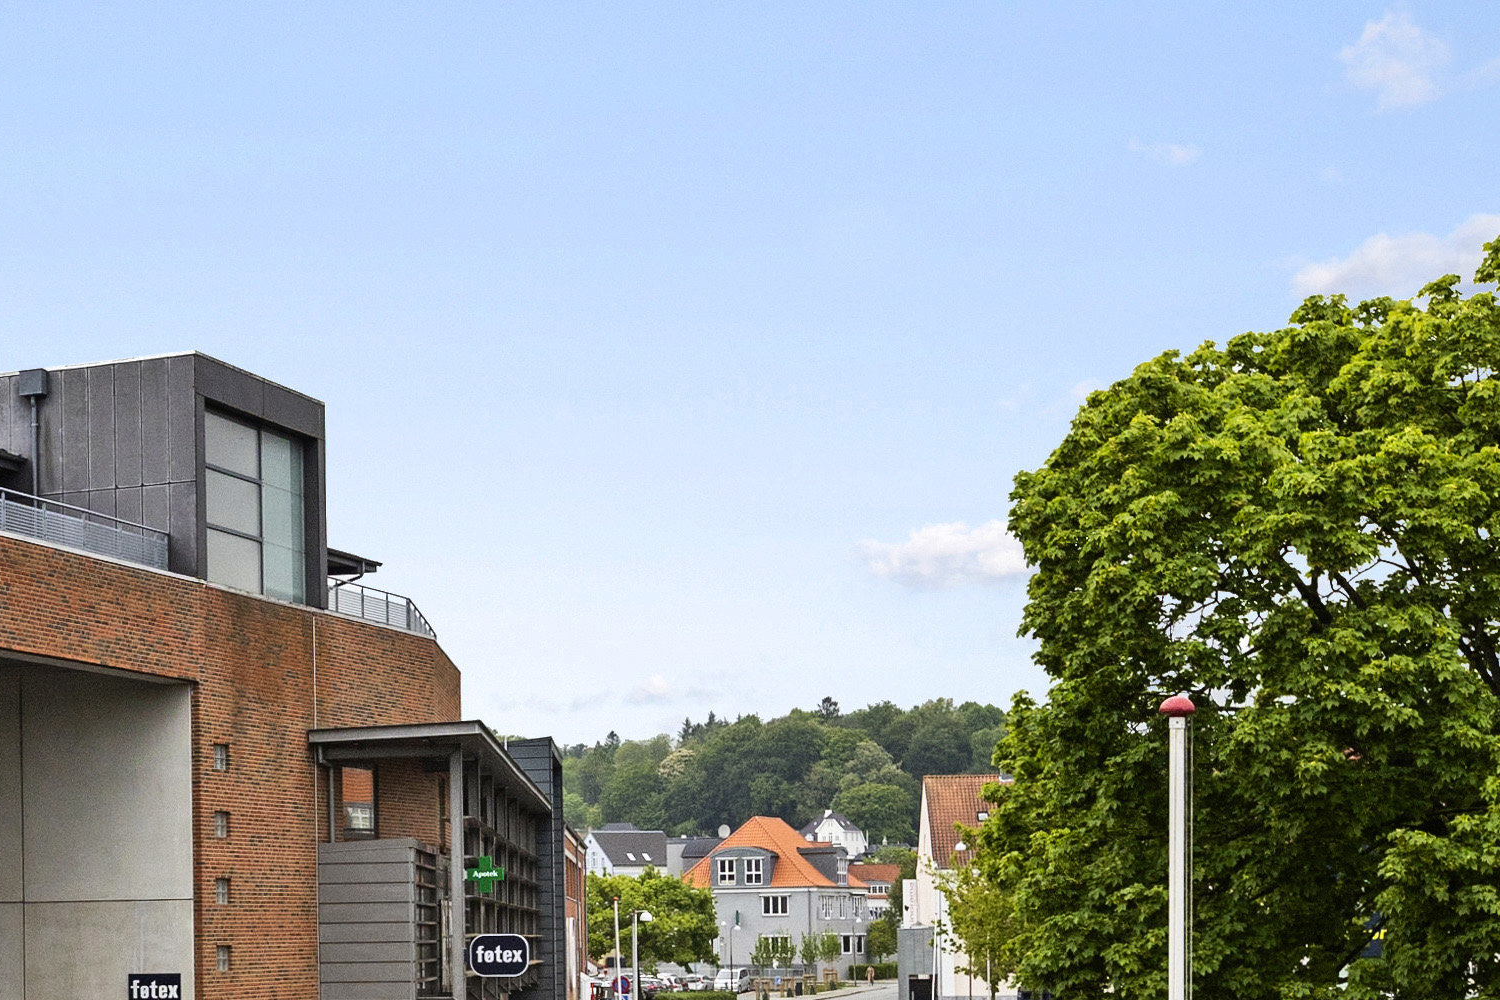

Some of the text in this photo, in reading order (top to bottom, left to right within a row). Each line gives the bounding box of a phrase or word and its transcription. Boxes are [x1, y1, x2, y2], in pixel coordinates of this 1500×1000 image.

[472, 870, 498, 878] Apotek
[476, 945, 523, 963] føtex
[130, 979, 179, 999] føtex
